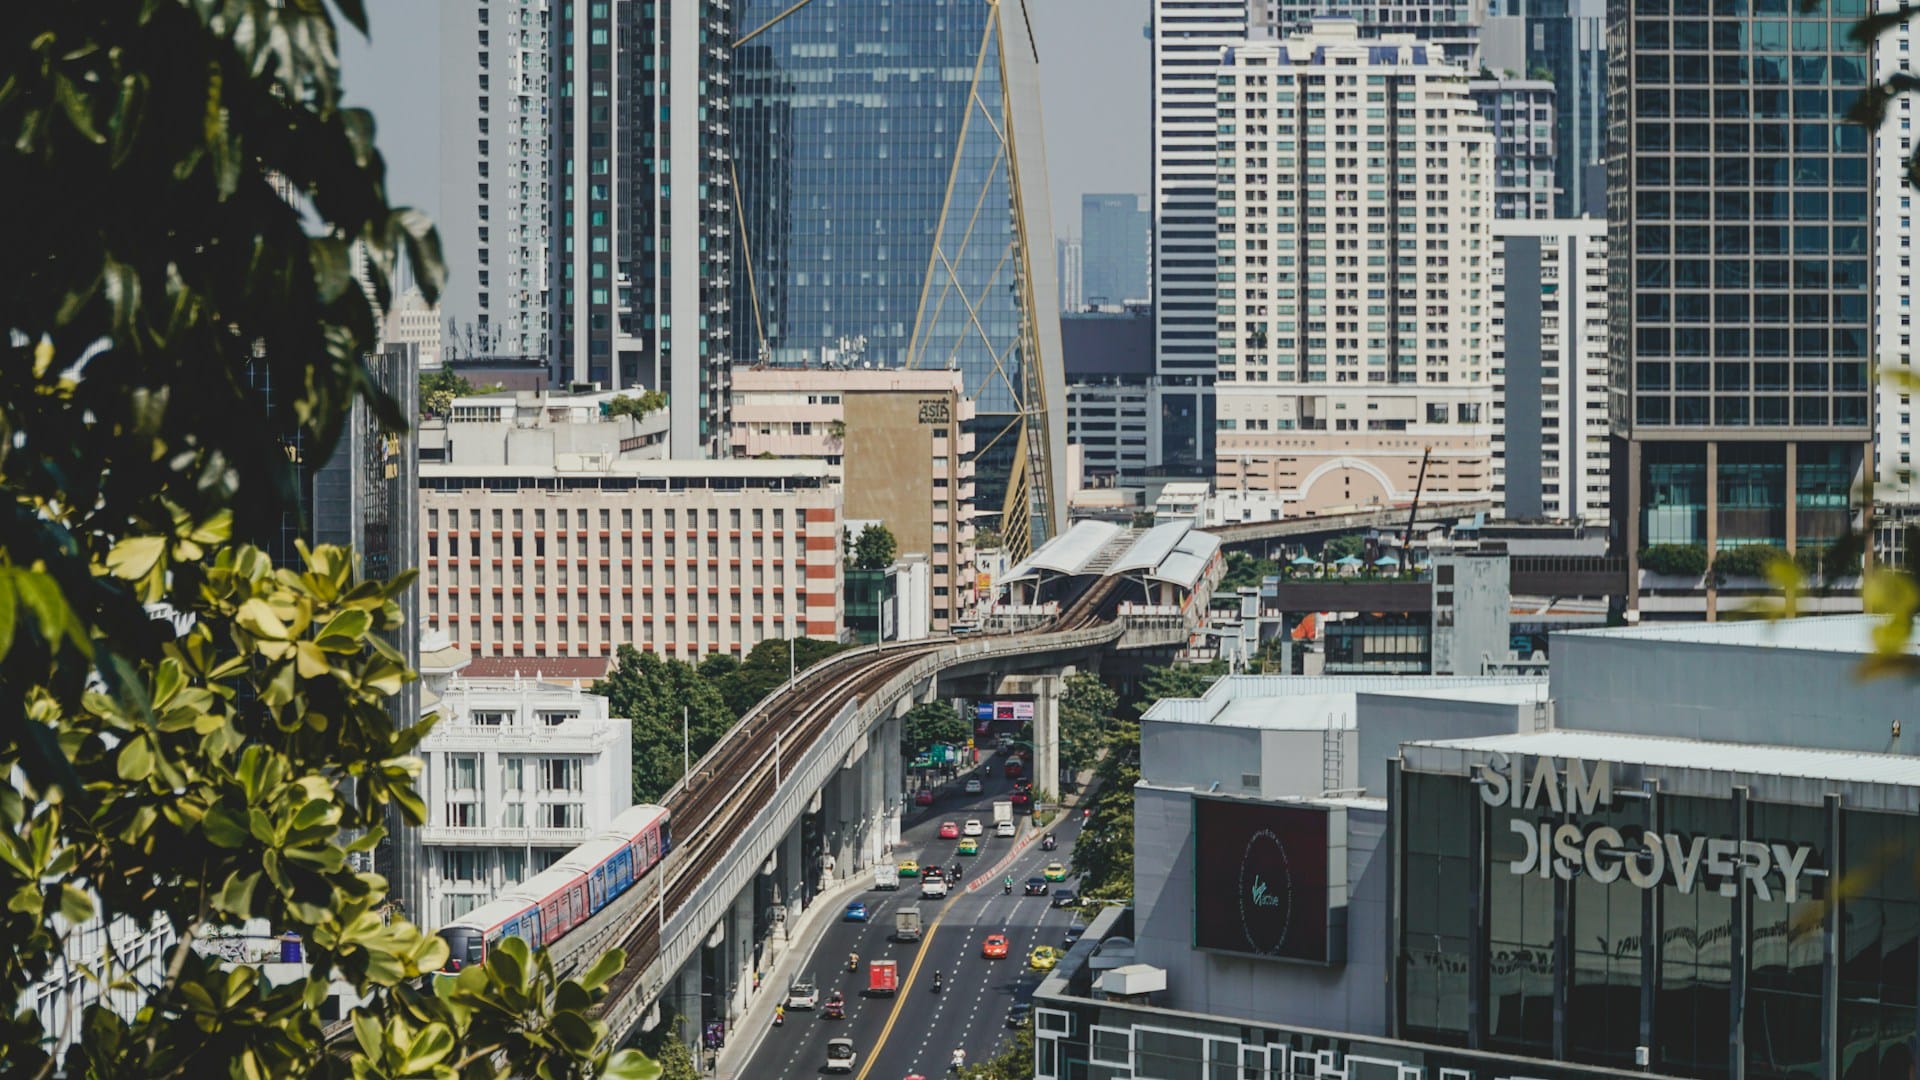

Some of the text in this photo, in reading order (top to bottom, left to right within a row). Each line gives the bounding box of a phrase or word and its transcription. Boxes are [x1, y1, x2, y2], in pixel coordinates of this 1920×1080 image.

[919, 404, 950, 418] ASIA
[1479, 752, 1613, 815] SIAM
[1510, 818, 1813, 903] DISCOVERY
